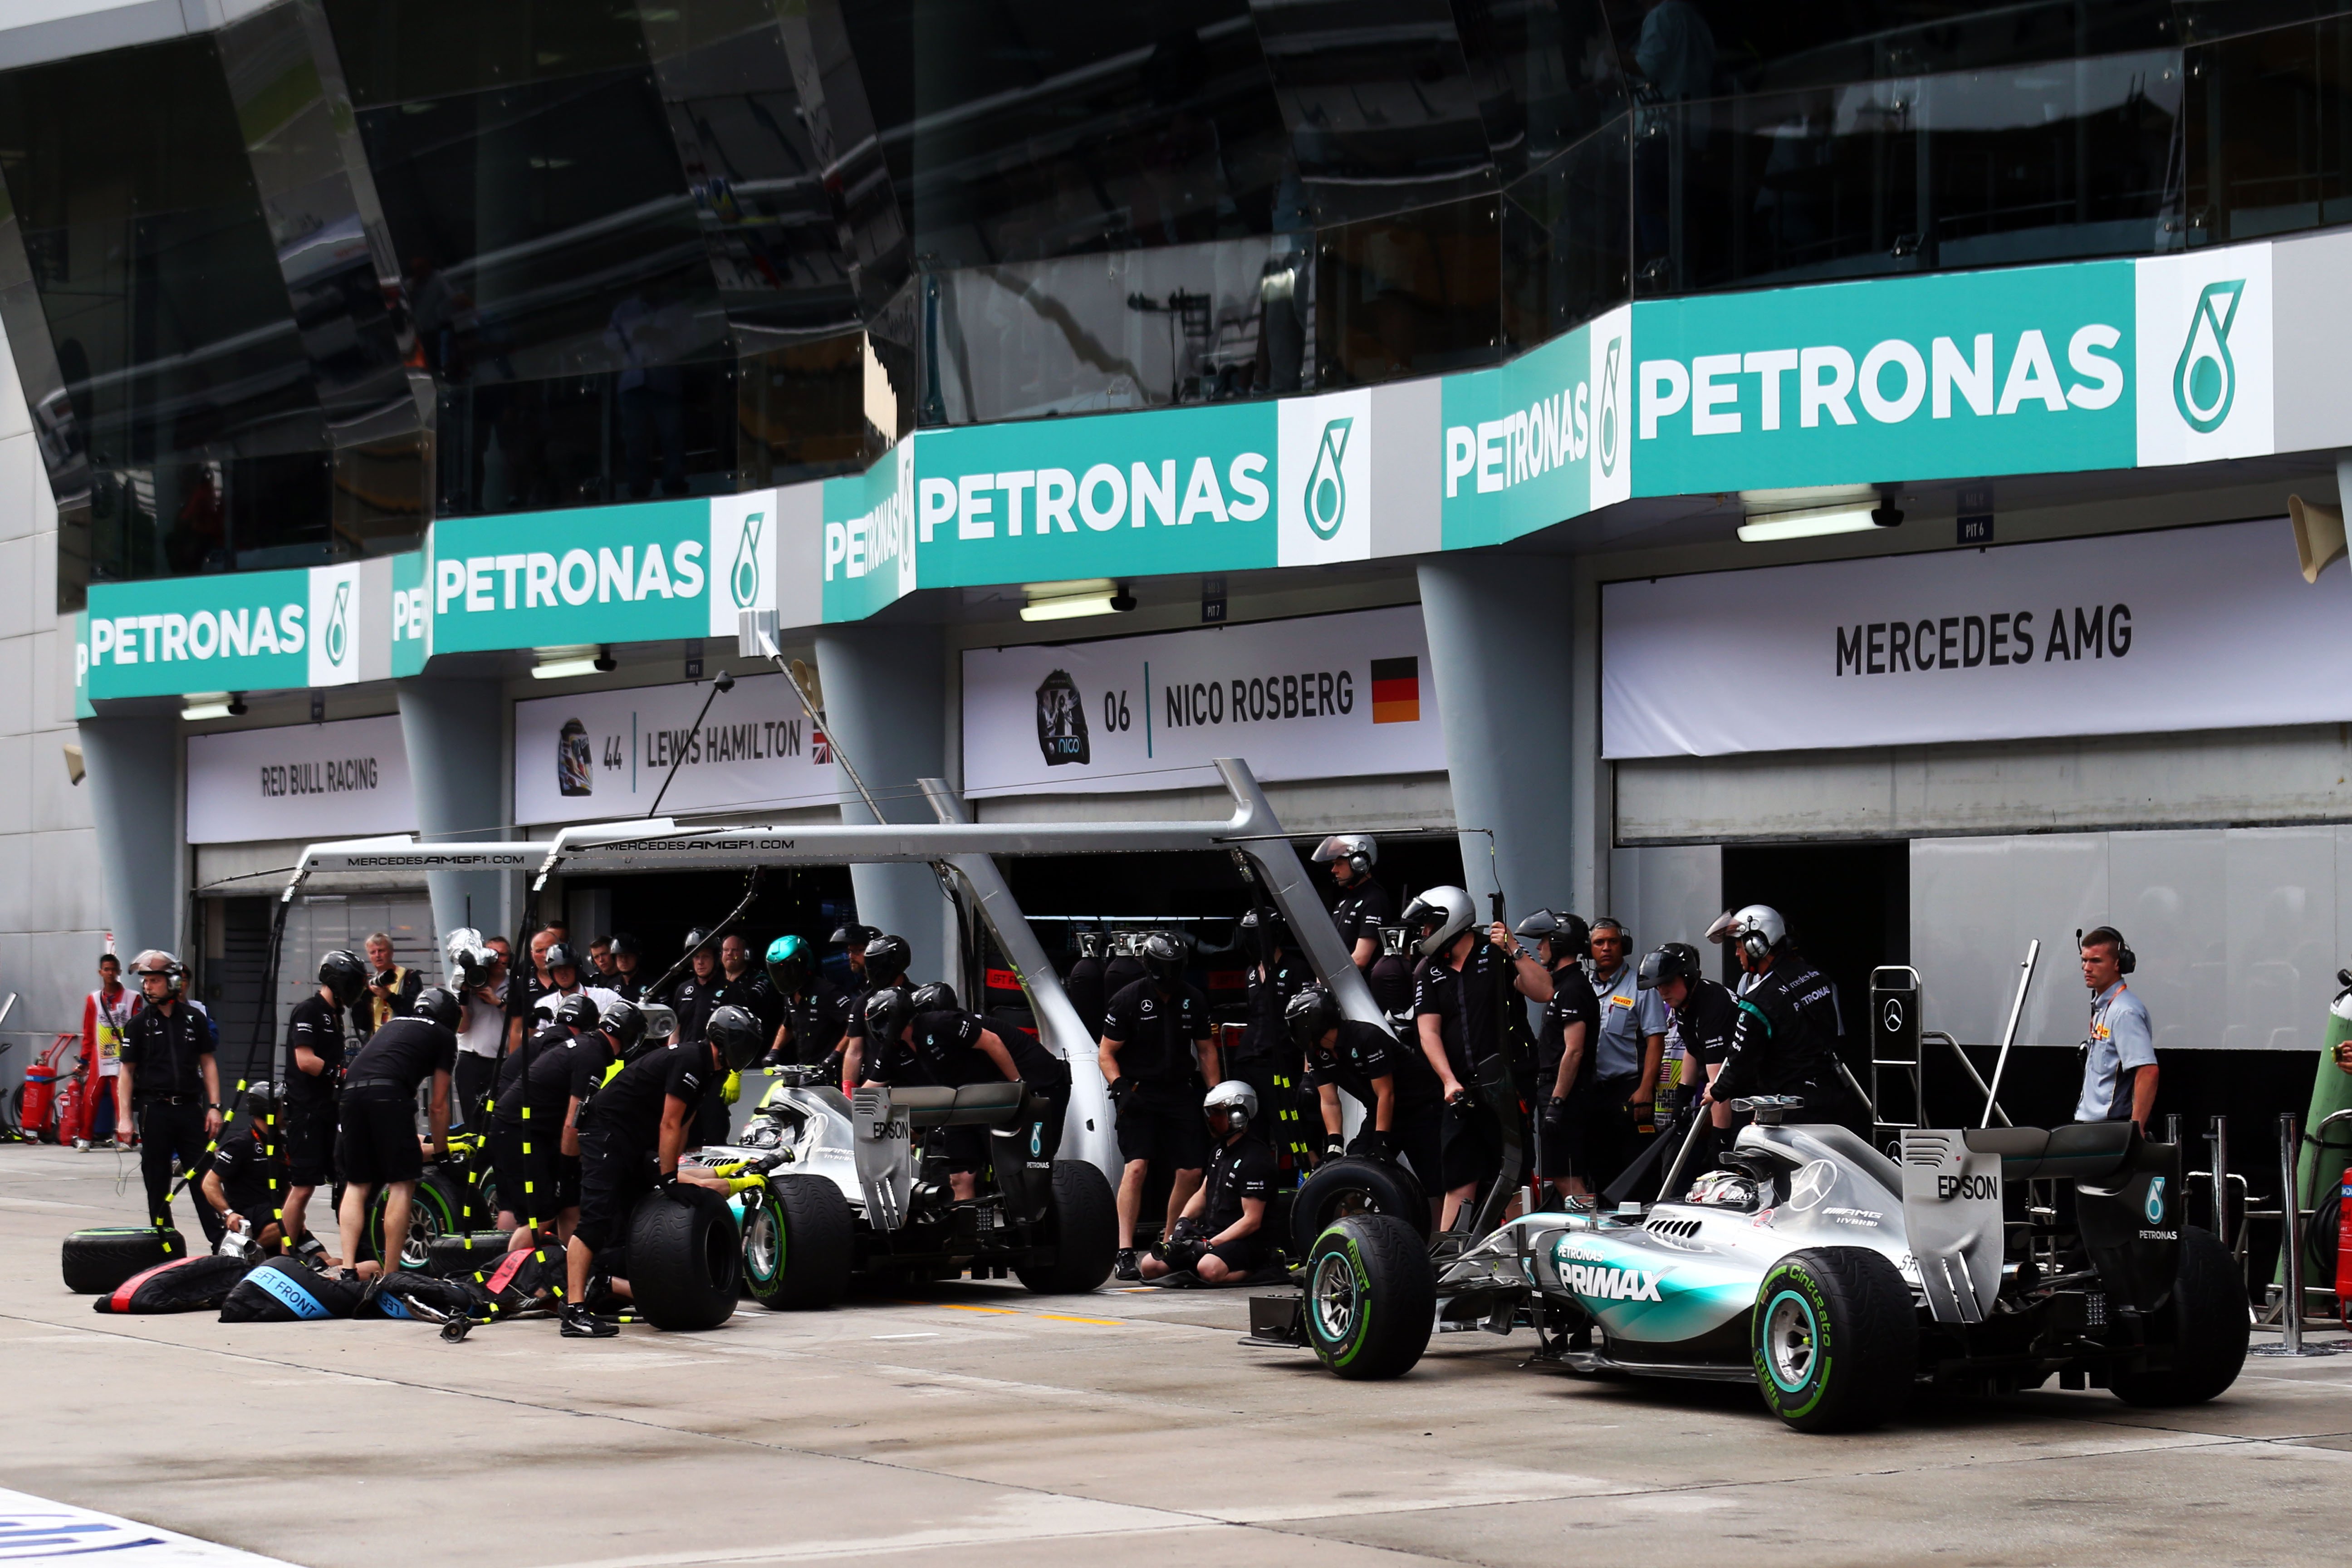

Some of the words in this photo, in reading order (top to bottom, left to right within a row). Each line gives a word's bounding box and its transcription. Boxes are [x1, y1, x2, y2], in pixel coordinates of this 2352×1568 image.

[1639, 324, 2124, 441] PETRONAS
[1446, 381, 1589, 498] PETRONAS
[920, 452, 1269, 543] PETRONAS
[825, 492, 899, 582] PETRONAS
[1966, 523, 1978, 538] PIT
[1980, 522, 1984, 536] 6
[436, 540, 705, 614] PETRONAS
[1217, 604, 1220, 616] 7
[91, 604, 306, 666] PETRONAS
[1835, 610, 2035, 677] MERCEDES
[2044, 603, 2133, 662] AMG
[1104, 690, 1131, 733] 06
[1166, 681, 1224, 728] NICO
[1232, 670, 1354, 722] ROSBERG
[603, 736, 622, 771] 44
[647, 727, 701, 768] LEWIS
[706, 720, 801, 763] HAMILTON
[262, 765, 287, 797] RED
[290, 763, 324, 795] BULL
[328, 757, 377, 792] RACING
[348, 856, 525, 866] MERCEDESAMGF1.COM
[874, 1122, 908, 1139] EPSON
[1938, 1175, 1998, 1200] EPSON
[1836, 1217, 1878, 1227] HYBRID
[1838, 1208, 1883, 1219] AMG
[1558, 1245, 1605, 1262] PETRONAS
[2139, 1230, 2178, 1240] PETRONAS
[251, 1270, 278, 1285] LEFT
[274, 1281, 318, 1316] FRONT
[1558, 1261, 1674, 1302] PRIMAX
[1789, 1264, 1831, 1347] Cinturato
